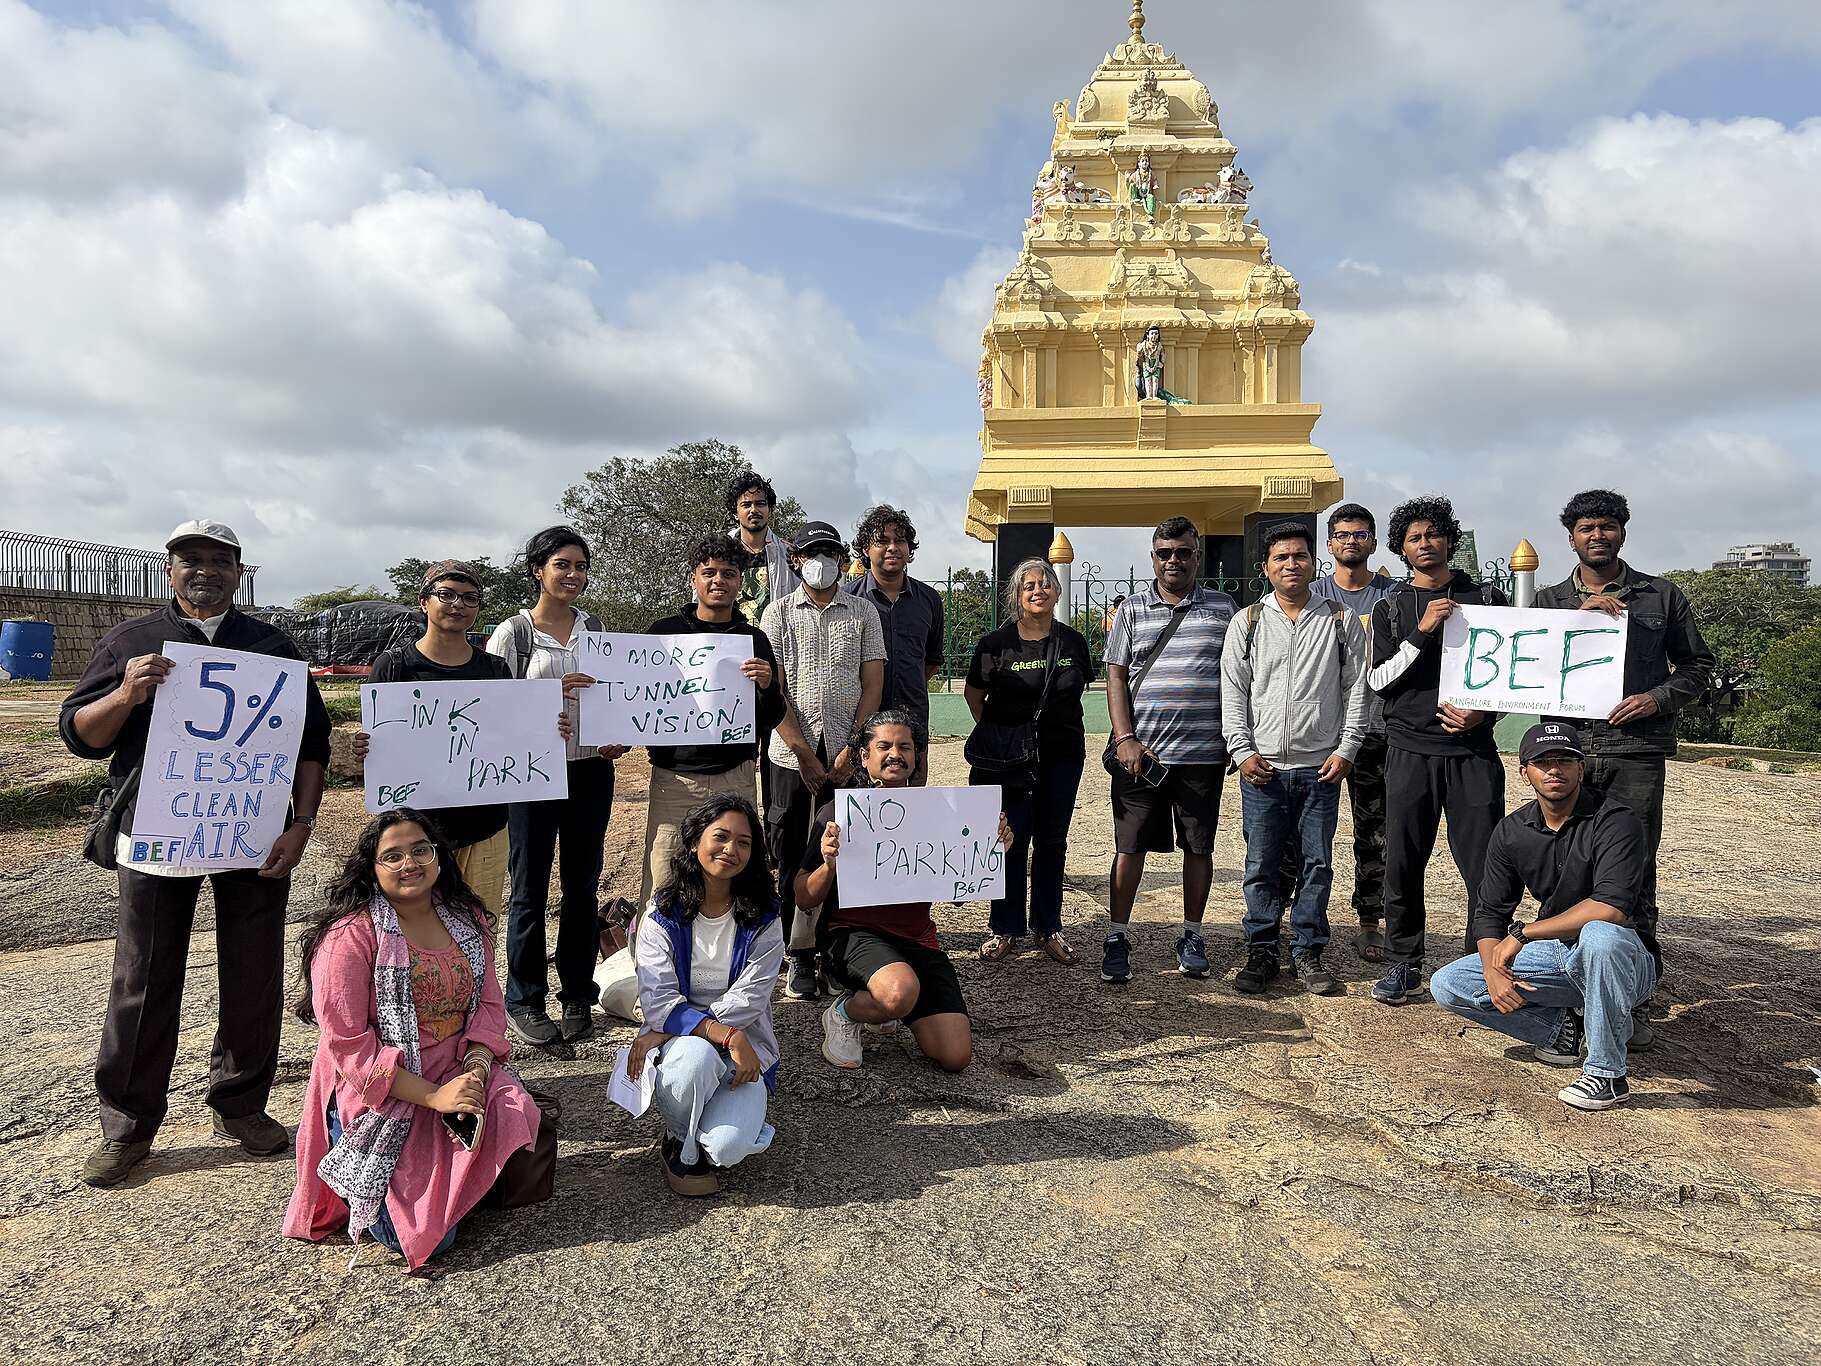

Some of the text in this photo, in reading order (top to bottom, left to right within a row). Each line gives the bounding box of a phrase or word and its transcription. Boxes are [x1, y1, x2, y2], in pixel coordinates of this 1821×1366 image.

[628, 646, 716, 668] MORE
[1011, 658, 1072, 672] GREENCE
[1464, 628, 1620, 703] BEF
[597, 677, 726, 702] TUNNEL
[184, 661, 288, 747] 5%
[1449, 696, 1586, 712] BANGALORE ENVIRONMENT FORUM
[721, 723, 752, 744] BEF
[1536, 735, 1571, 744] HONDA
[165, 751, 291, 785] LESSER
[467, 751, 551, 792] PARK
[171, 790, 263, 818] CLEAN
[377, 781, 421, 806] BEF
[847, 793, 906, 843] NO
[132, 821, 264, 862] BEF AIR
